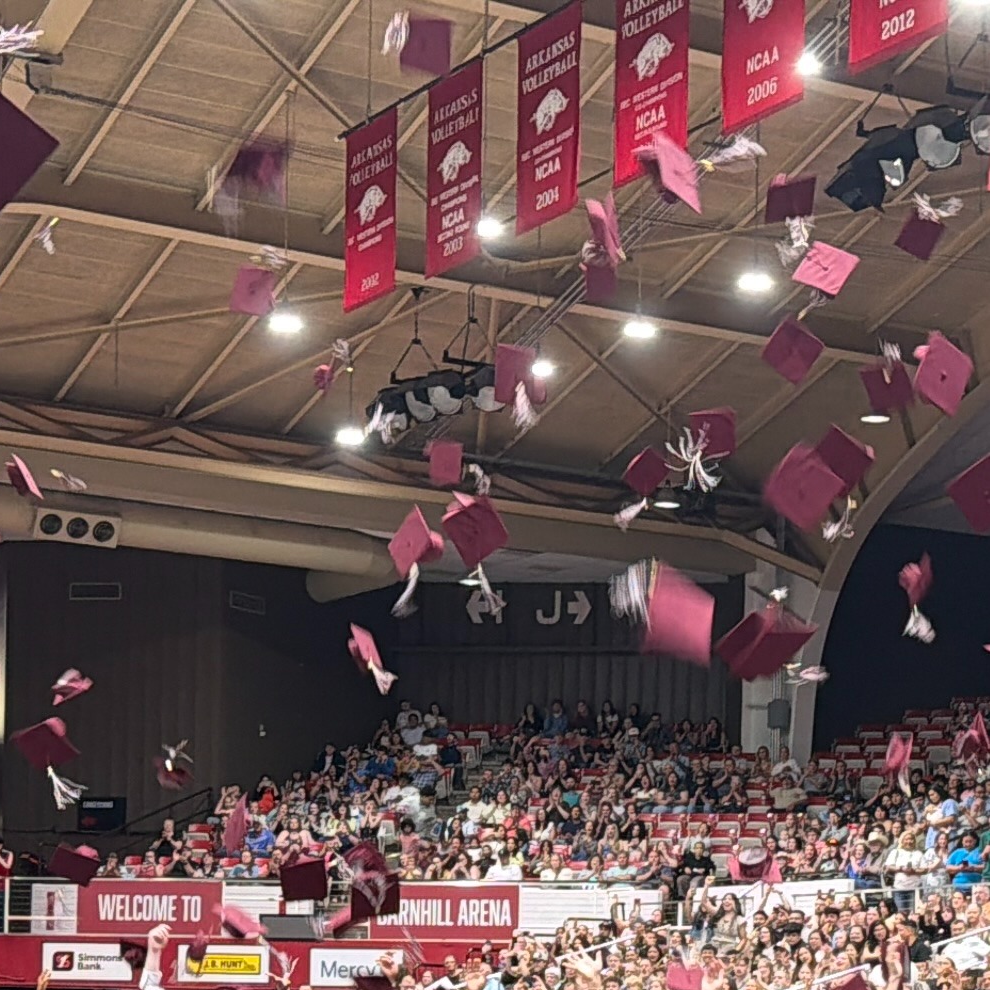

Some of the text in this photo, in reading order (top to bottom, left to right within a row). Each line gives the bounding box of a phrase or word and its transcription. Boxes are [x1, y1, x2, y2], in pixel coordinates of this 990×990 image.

[881, 8, 915, 40] 2012
[524, 30, 576, 75] ARKANSAS
[746, 45, 780, 76] NCAA
[521, 50, 577, 96] VOLLEYBALL
[747, 76, 778, 107] 2006
[635, 104, 666, 132] NCAA
[534, 156, 561, 183] NCAA
[535, 185, 560, 211] 2004
[441, 207, 465, 231] NCAA
[442, 235, 464, 257] 2003
[536, 590, 562, 624] J
[98, 894, 202, 923] WELCOME TO
[457, 899, 512, 926] ARENA
[78, 953, 123, 962] Simmons
[220, 960, 243, 969] HUNT
[321, 960, 376, 978] Mercy
